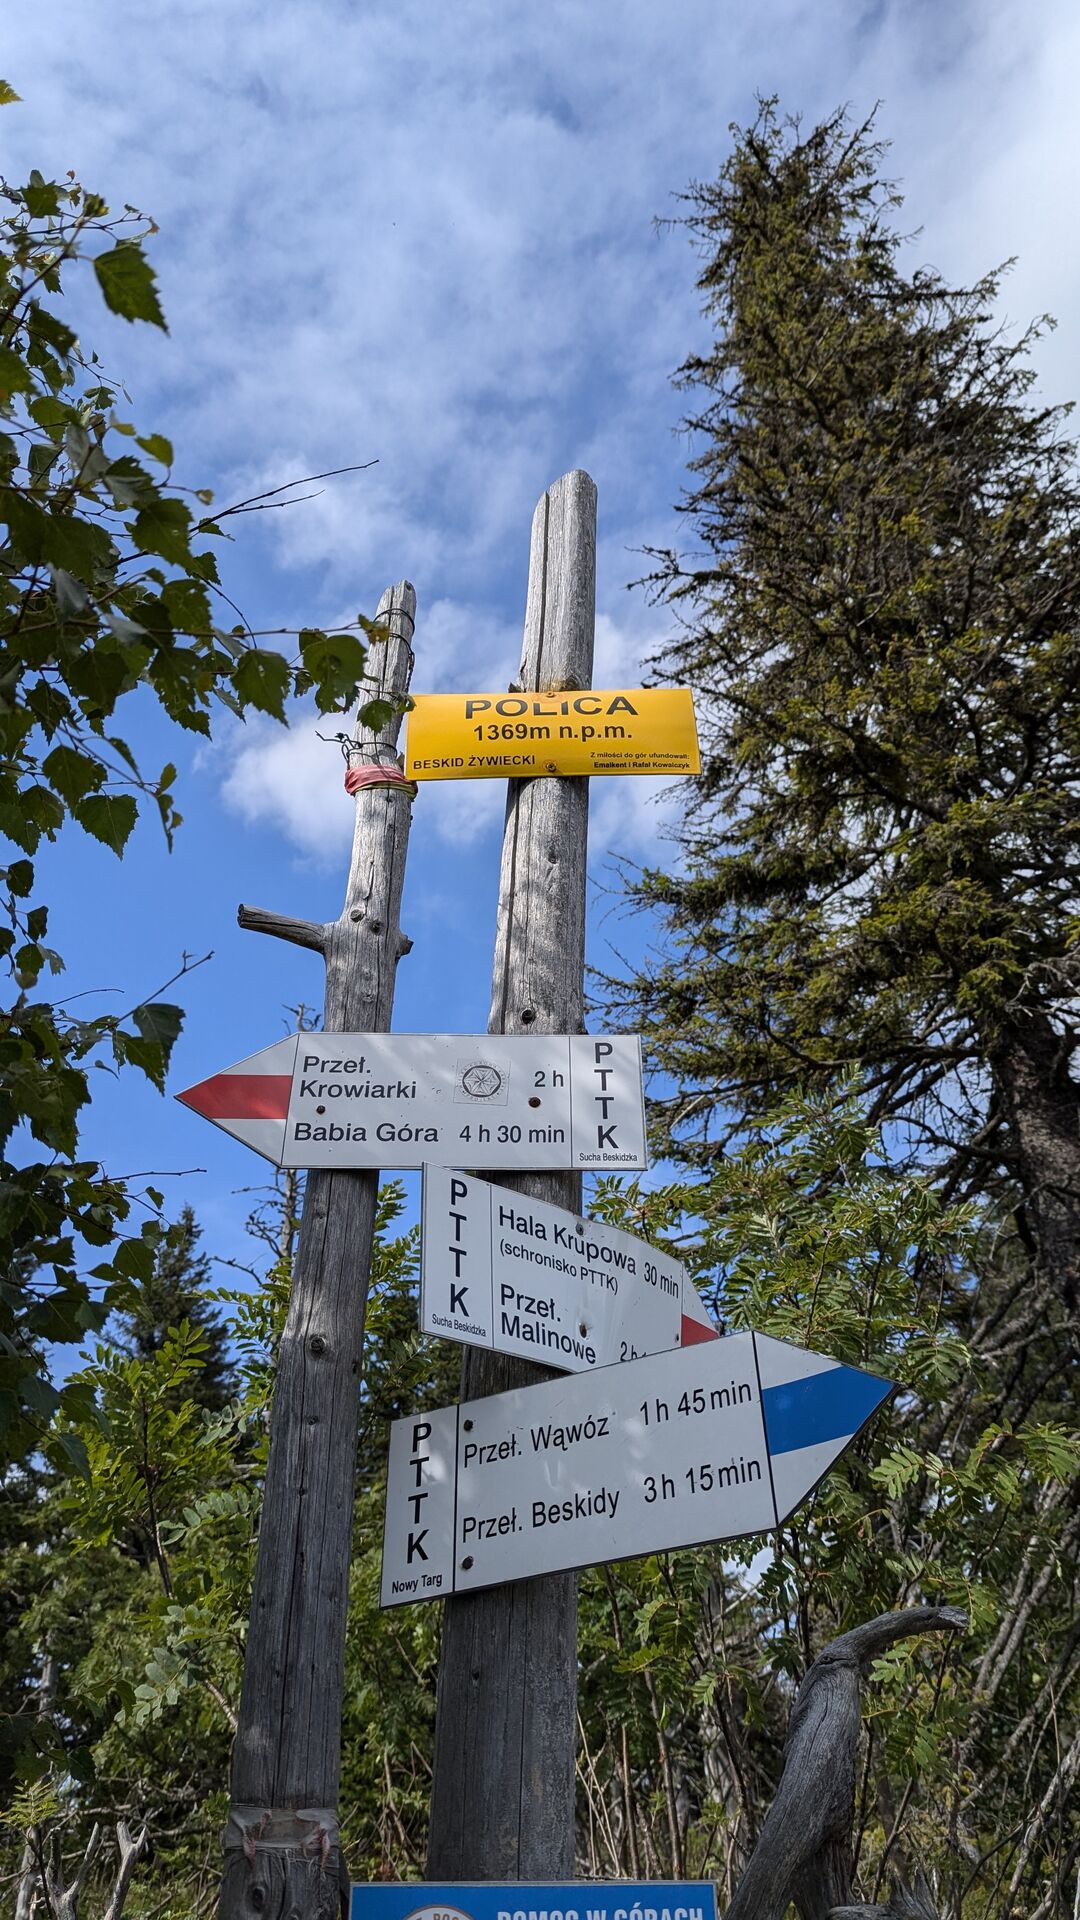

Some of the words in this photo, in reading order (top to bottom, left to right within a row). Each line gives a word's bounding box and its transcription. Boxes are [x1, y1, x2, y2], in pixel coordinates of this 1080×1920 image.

[464, 695, 639, 720] POLICA
[473, 722, 551, 742] 1369m
[559, 723, 634, 743] n.p.m.
[412, 756, 465, 771] BESKID
[467, 754, 537, 768] ŻYWIECKI
[302, 1054, 372, 1075] Przeł.
[299, 1079, 418, 1100] Krowiarki
[293, 1121, 368, 1143] Babia
[375, 1121, 440, 1143] Góra
[458, 1123, 473, 1144] 4
[478, 1123, 491, 1144] h
[496, 1123, 523, 1144] 30
[528, 1123, 566, 1145] min
[579, 1152, 602, 1162] Sucha
[602, 1152, 639, 1162] Beskidzka
[498, 1206, 548, 1242] Hala
[553, 1223, 637, 1276] Krupowa
[643, 1261, 659, 1288] 30
[659, 1273, 680, 1300] min
[499, 1238, 578, 1278] (schronisko
[579, 1265, 619, 1296] PTTK)
[500, 1284, 562, 1322] Przeł.
[431, 1313, 453, 1329] Sucha
[453, 1319, 487, 1338] Beskidzka
[500, 1312, 597, 1366] Malinowe
[463, 1433, 523, 1468] Przeł.
[530, 1414, 610, 1452] Wąwóz
[462, 1506, 523, 1544] Przeł.
[532, 1486, 621, 1529] Beskidy
[391, 1580, 418, 1594] Nowy
[421, 1573, 442, 1588] Targ
